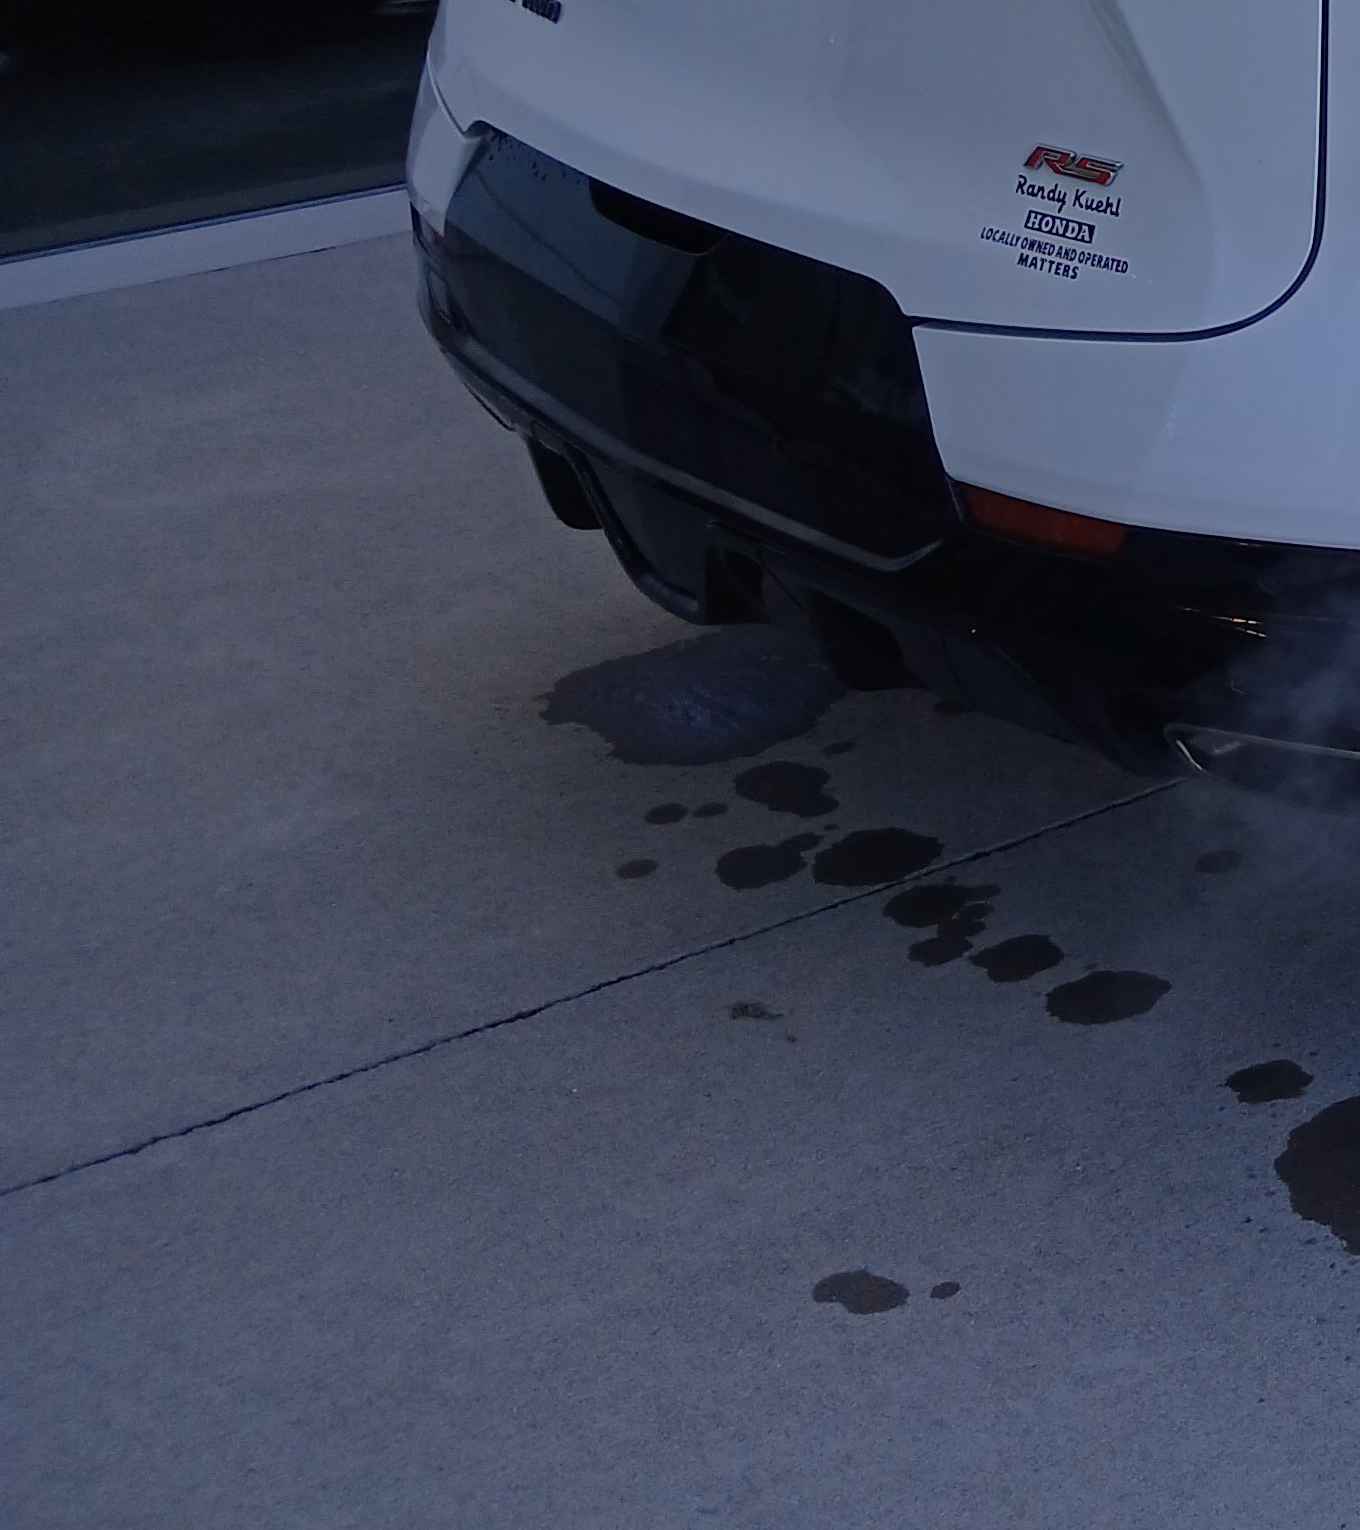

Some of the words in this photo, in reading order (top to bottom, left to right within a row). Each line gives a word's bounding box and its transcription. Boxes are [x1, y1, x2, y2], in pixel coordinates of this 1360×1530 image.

[1022, 143, 1125, 187] RS
[1015, 174, 1068, 214] Randy
[1072, 188, 1122, 217] Kuehl
[1027, 212, 1092, 242] HONDA
[980, 227, 1021, 247] LOCALLY
[1020, 236, 1056, 256] OWNED
[1055, 245, 1077, 262] AND
[1077, 250, 1129, 274] OPERATED
[1017, 252, 1080, 280] MATTERS
